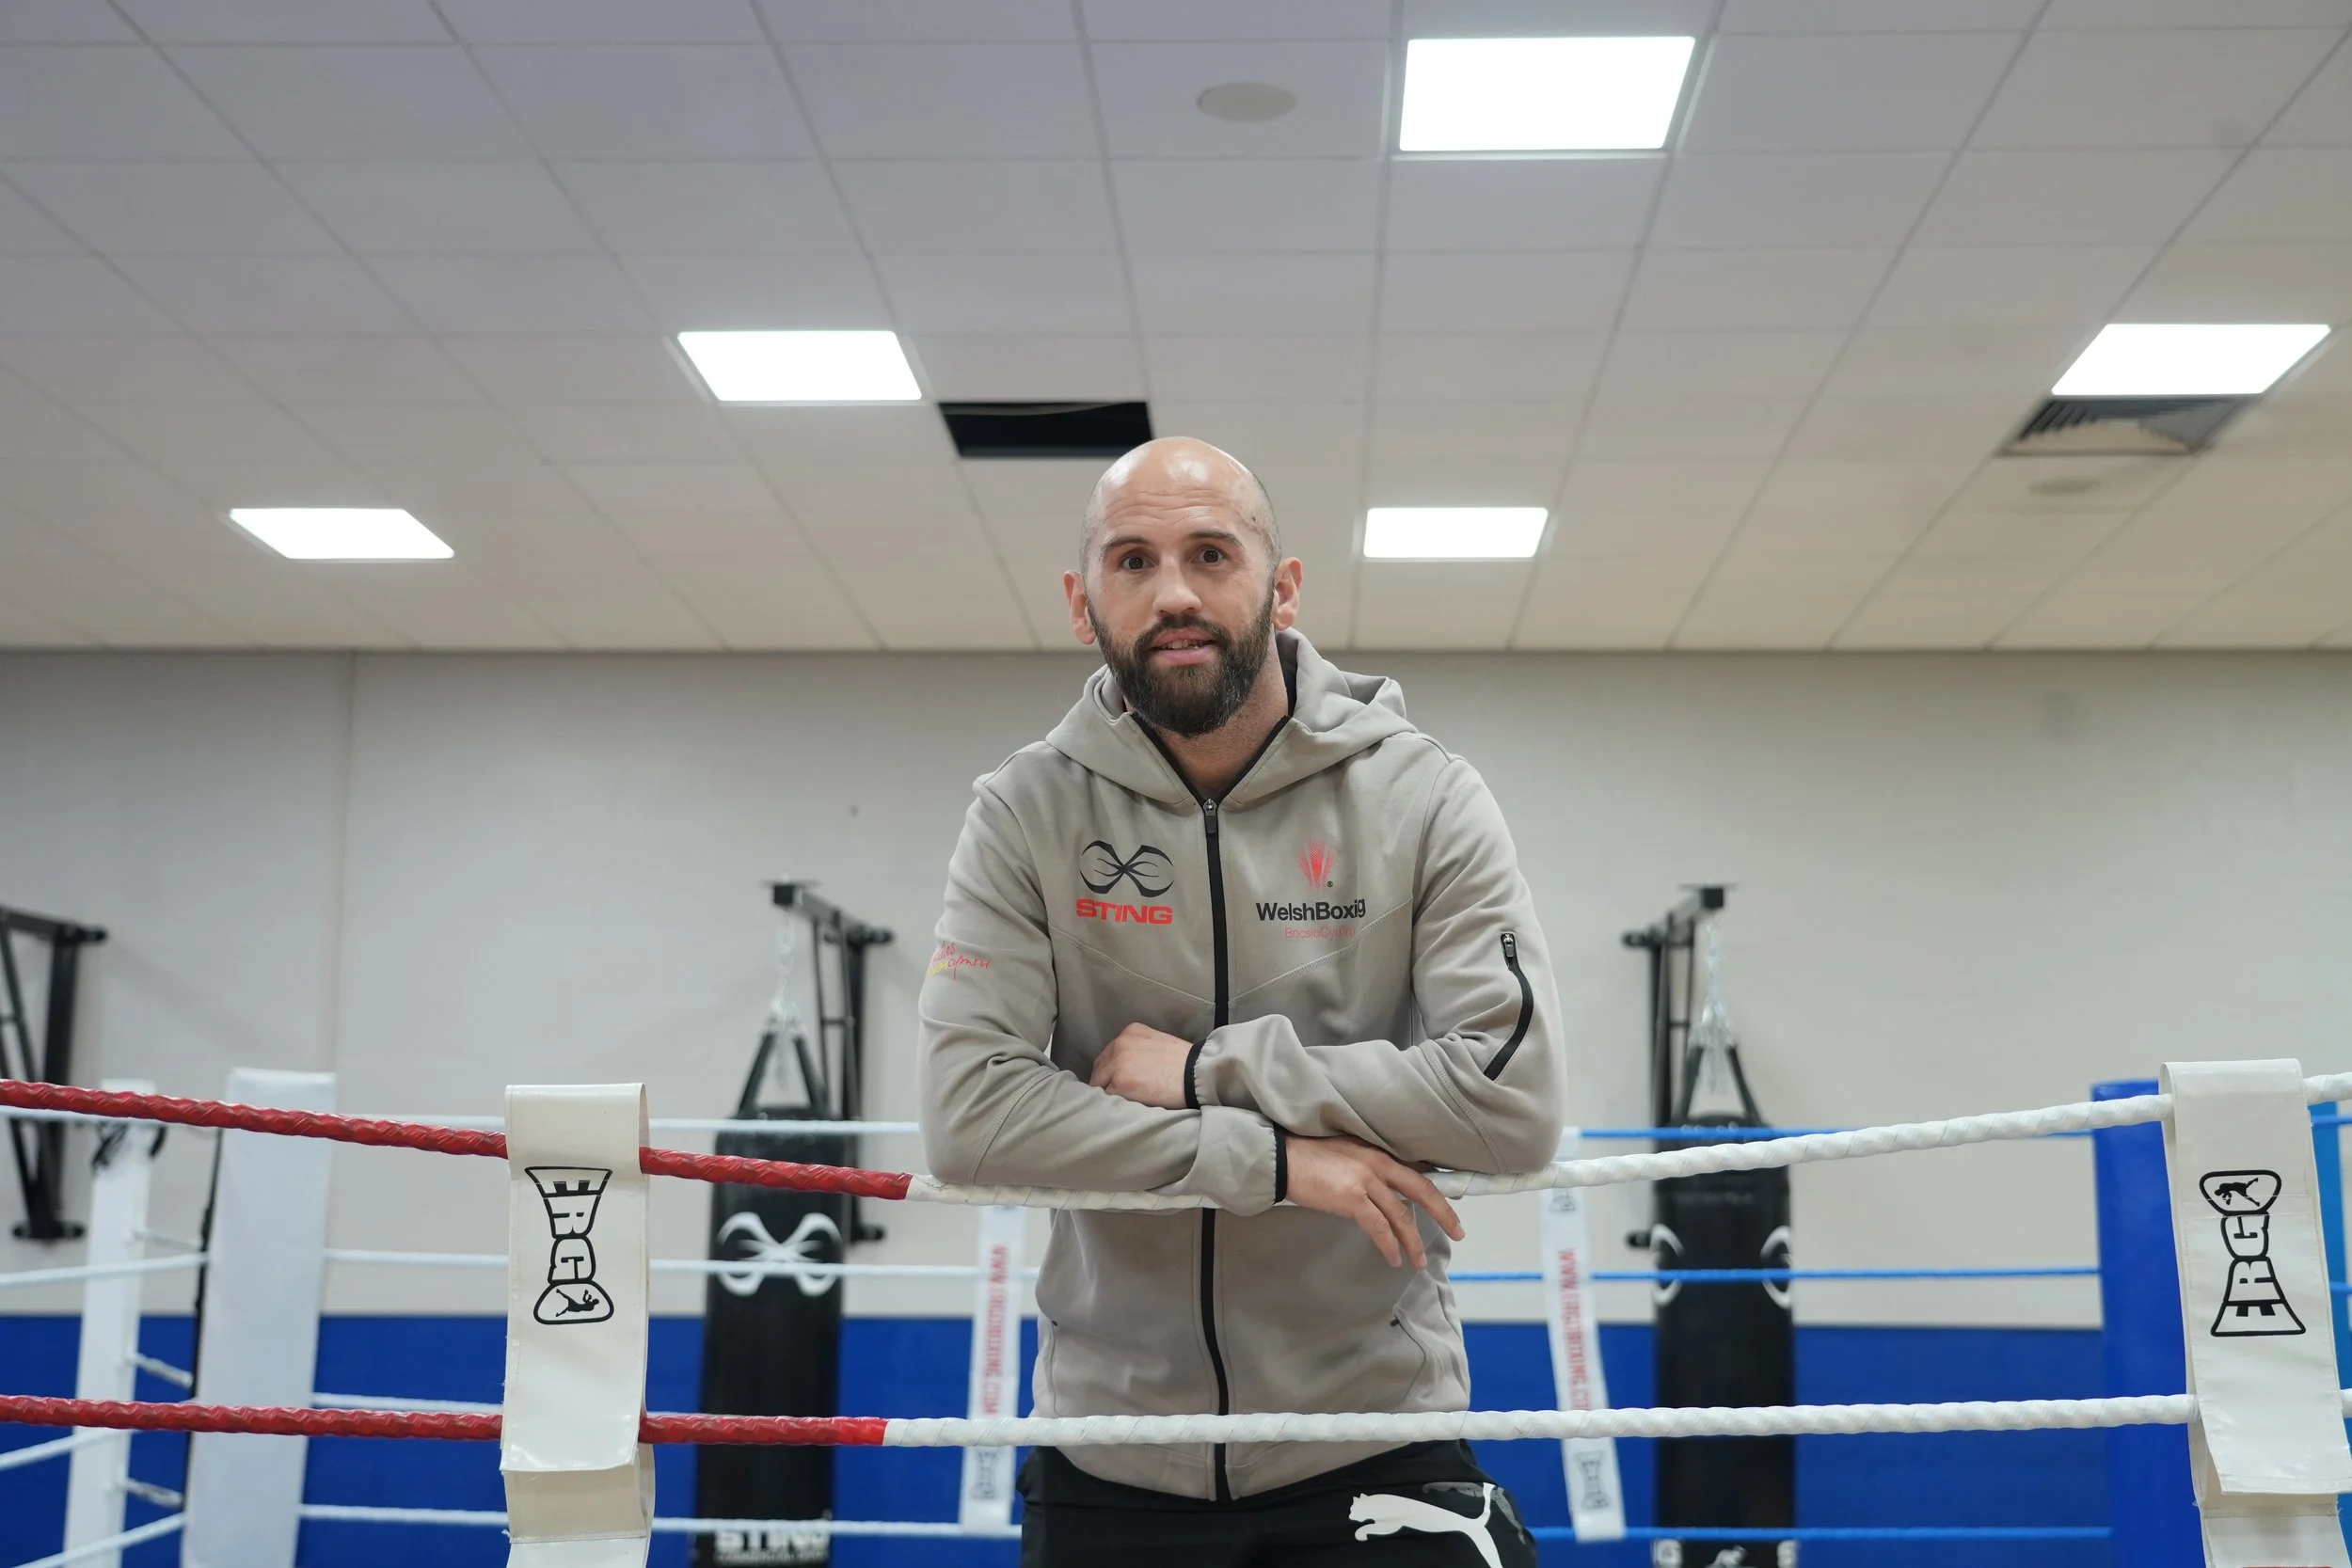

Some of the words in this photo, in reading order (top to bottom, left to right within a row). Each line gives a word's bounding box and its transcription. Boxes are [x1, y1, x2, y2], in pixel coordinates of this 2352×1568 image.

[1075, 898, 1173, 925] STING
[1256, 898, 1366, 922] WelshBoxig
[1558, 1249, 1591, 1410] WWW.ERGOBOXING.CO
